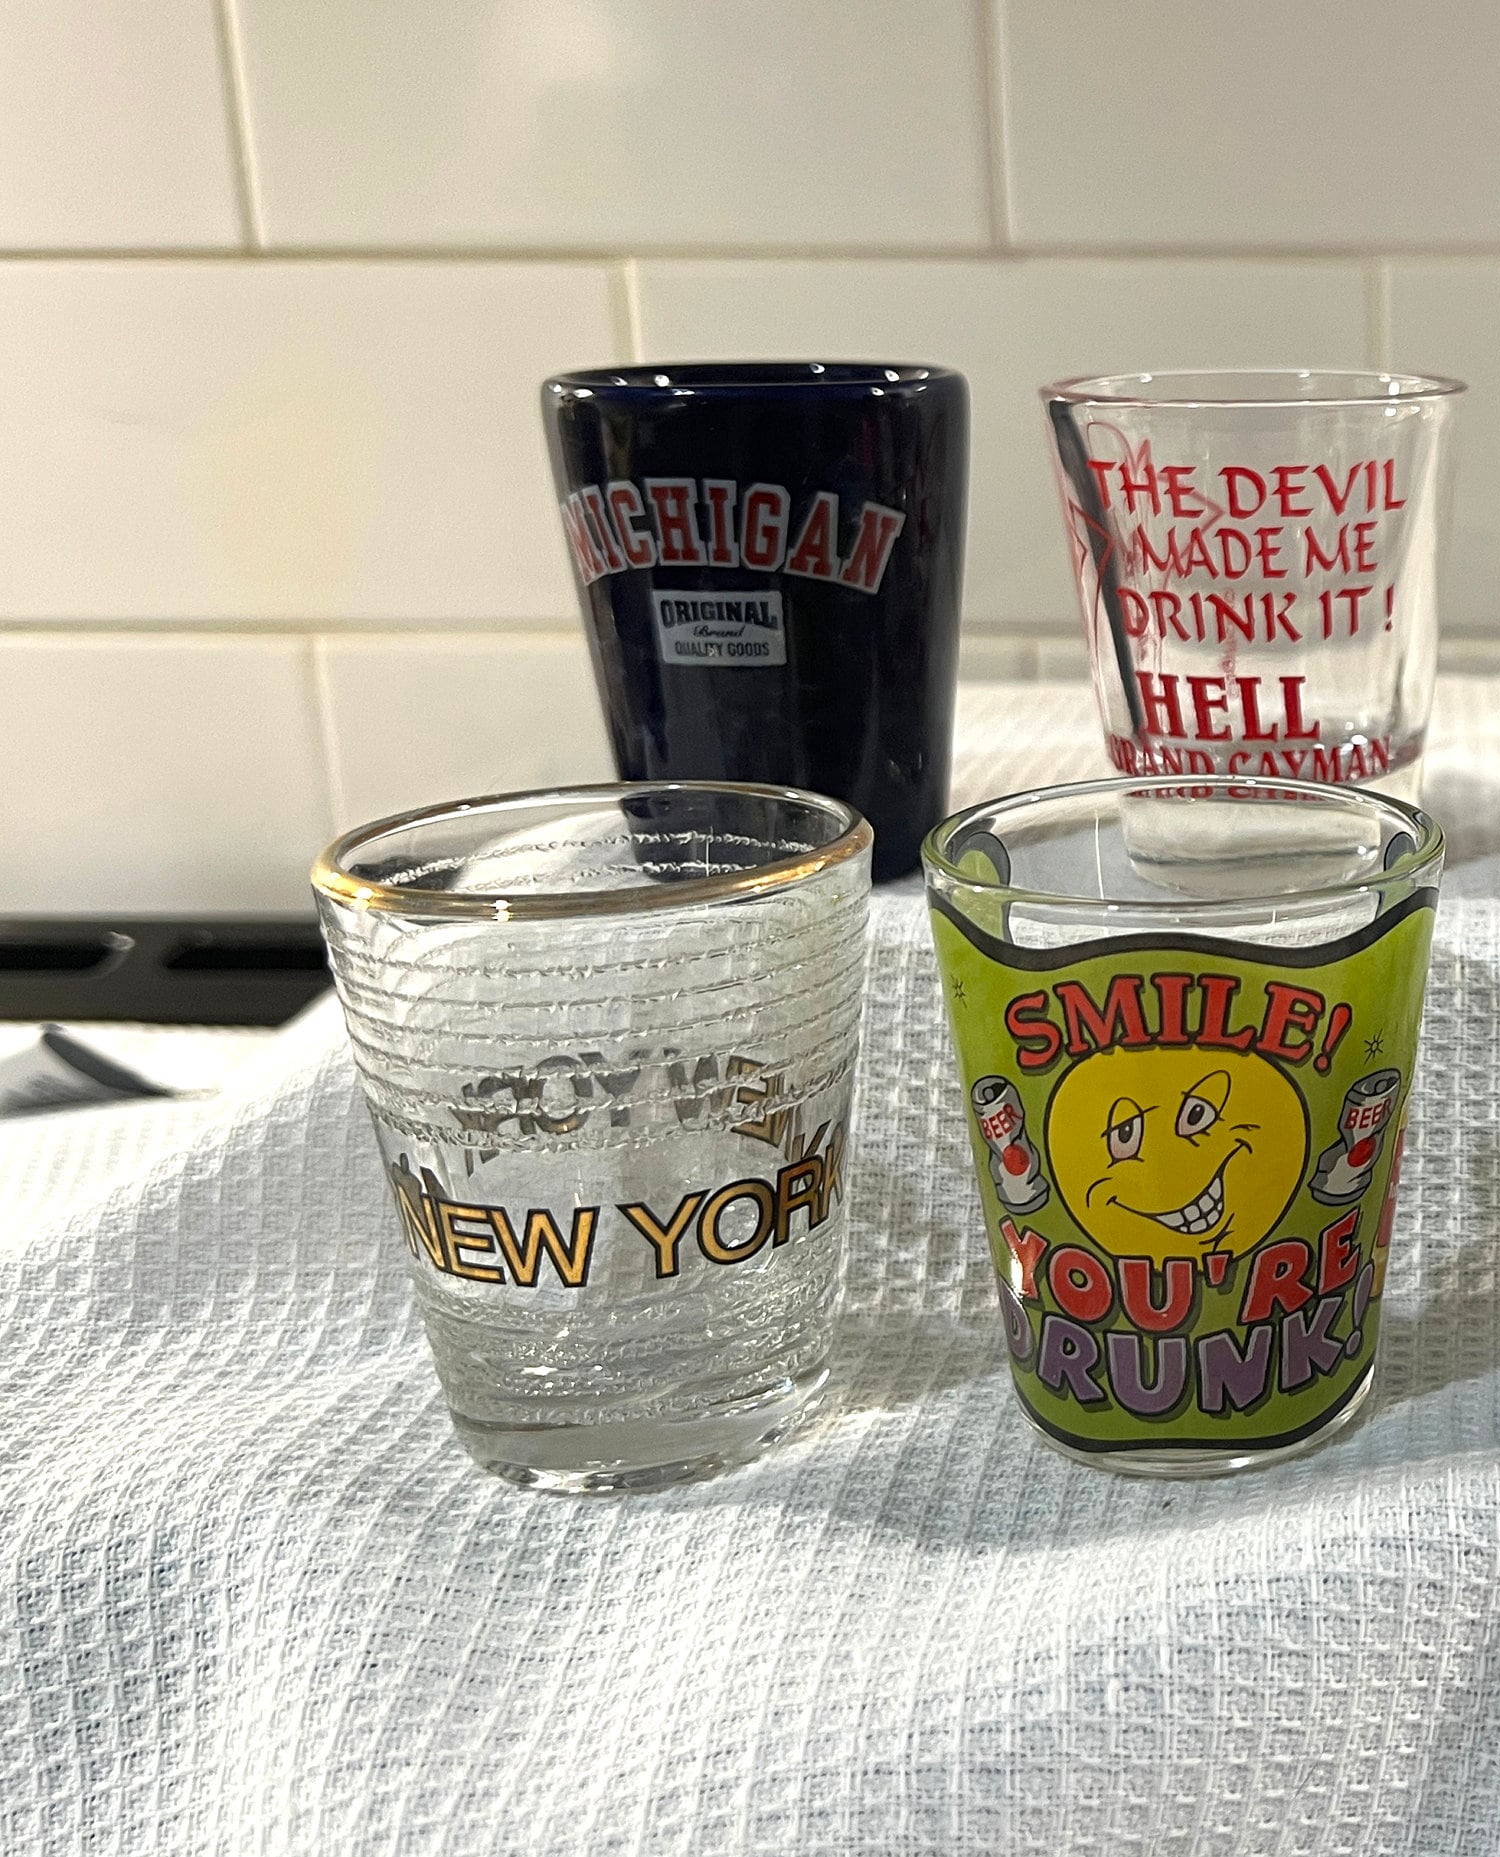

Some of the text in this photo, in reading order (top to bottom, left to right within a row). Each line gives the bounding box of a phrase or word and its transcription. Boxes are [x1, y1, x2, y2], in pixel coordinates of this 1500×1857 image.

[1087, 459, 1407, 519] THE DEVIL
[561, 476, 906, 595] MICHIGAN
[1136, 521, 1379, 579] MADE ME
[660, 599, 778, 630] ORIGINAL
[1117, 586, 1303, 643] DRINK
[675, 641, 770, 657] QUALITY GOODS
[1136, 671, 1321, 742] HELL
[1228, 734, 1392, 784] CAYMAN
[1004, 971, 1353, 1074] SMILE!
[980, 1103, 1023, 1140] BEER
[1344, 1097, 1391, 1130] BEER
[393, 1124, 845, 1289] NEW YORK
[998, 1206, 1363, 1333] YOU'RE
[1000, 1261, 1376, 1415] DRUNK!
